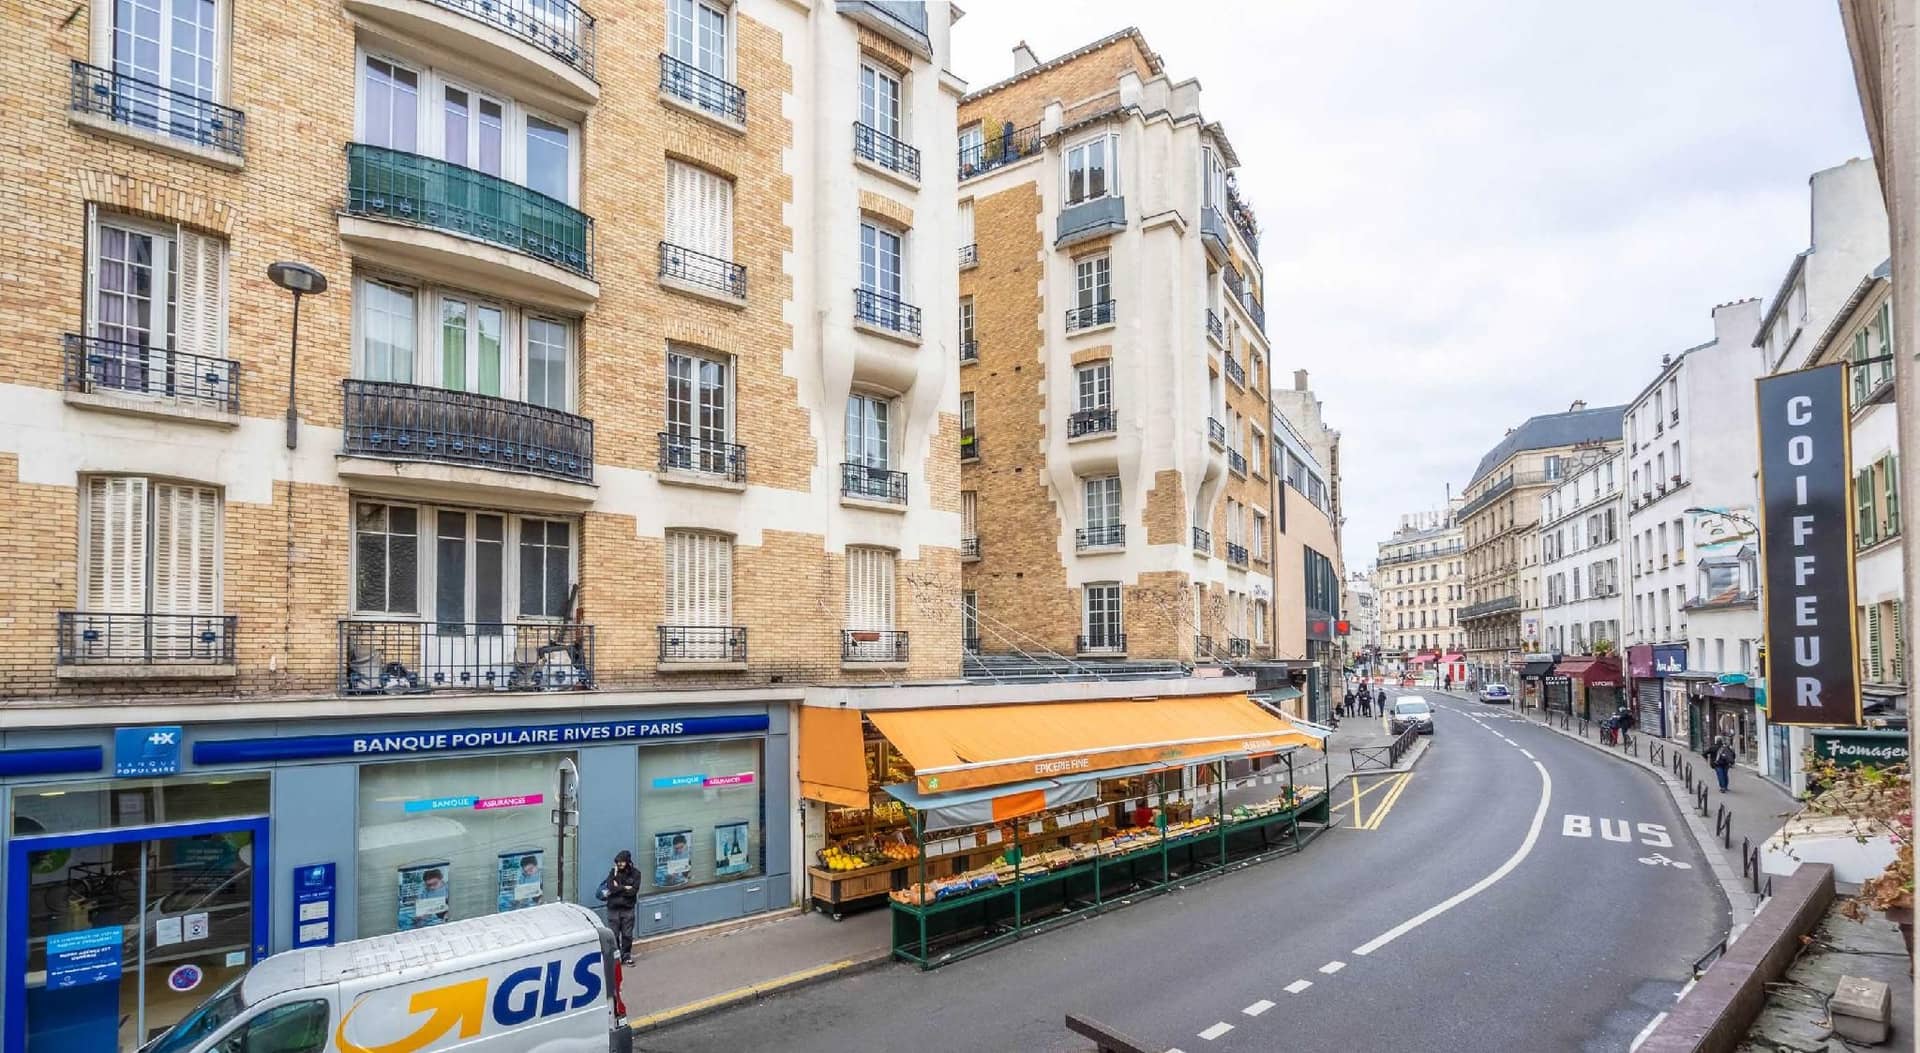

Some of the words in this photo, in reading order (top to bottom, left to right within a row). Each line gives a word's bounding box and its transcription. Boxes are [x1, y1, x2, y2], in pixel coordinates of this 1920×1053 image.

[1786, 396, 1823, 707] COIFFEUR
[353, 736, 446, 753] BANQUE
[452, 729, 559, 747] POPULAIRE
[564, 726, 611, 740] RIVES
[615, 725, 636, 737] DE
[640, 722, 684, 735] PARIS
[1034, 760, 1071, 774] EPICERIE
[1071, 758, 1089, 769] FINE
[432, 798, 469, 808] BANQUE
[483, 797, 527, 808] ASSURANCES
[1562, 814, 1673, 848] BUS
[492, 952, 603, 1026] GLS
